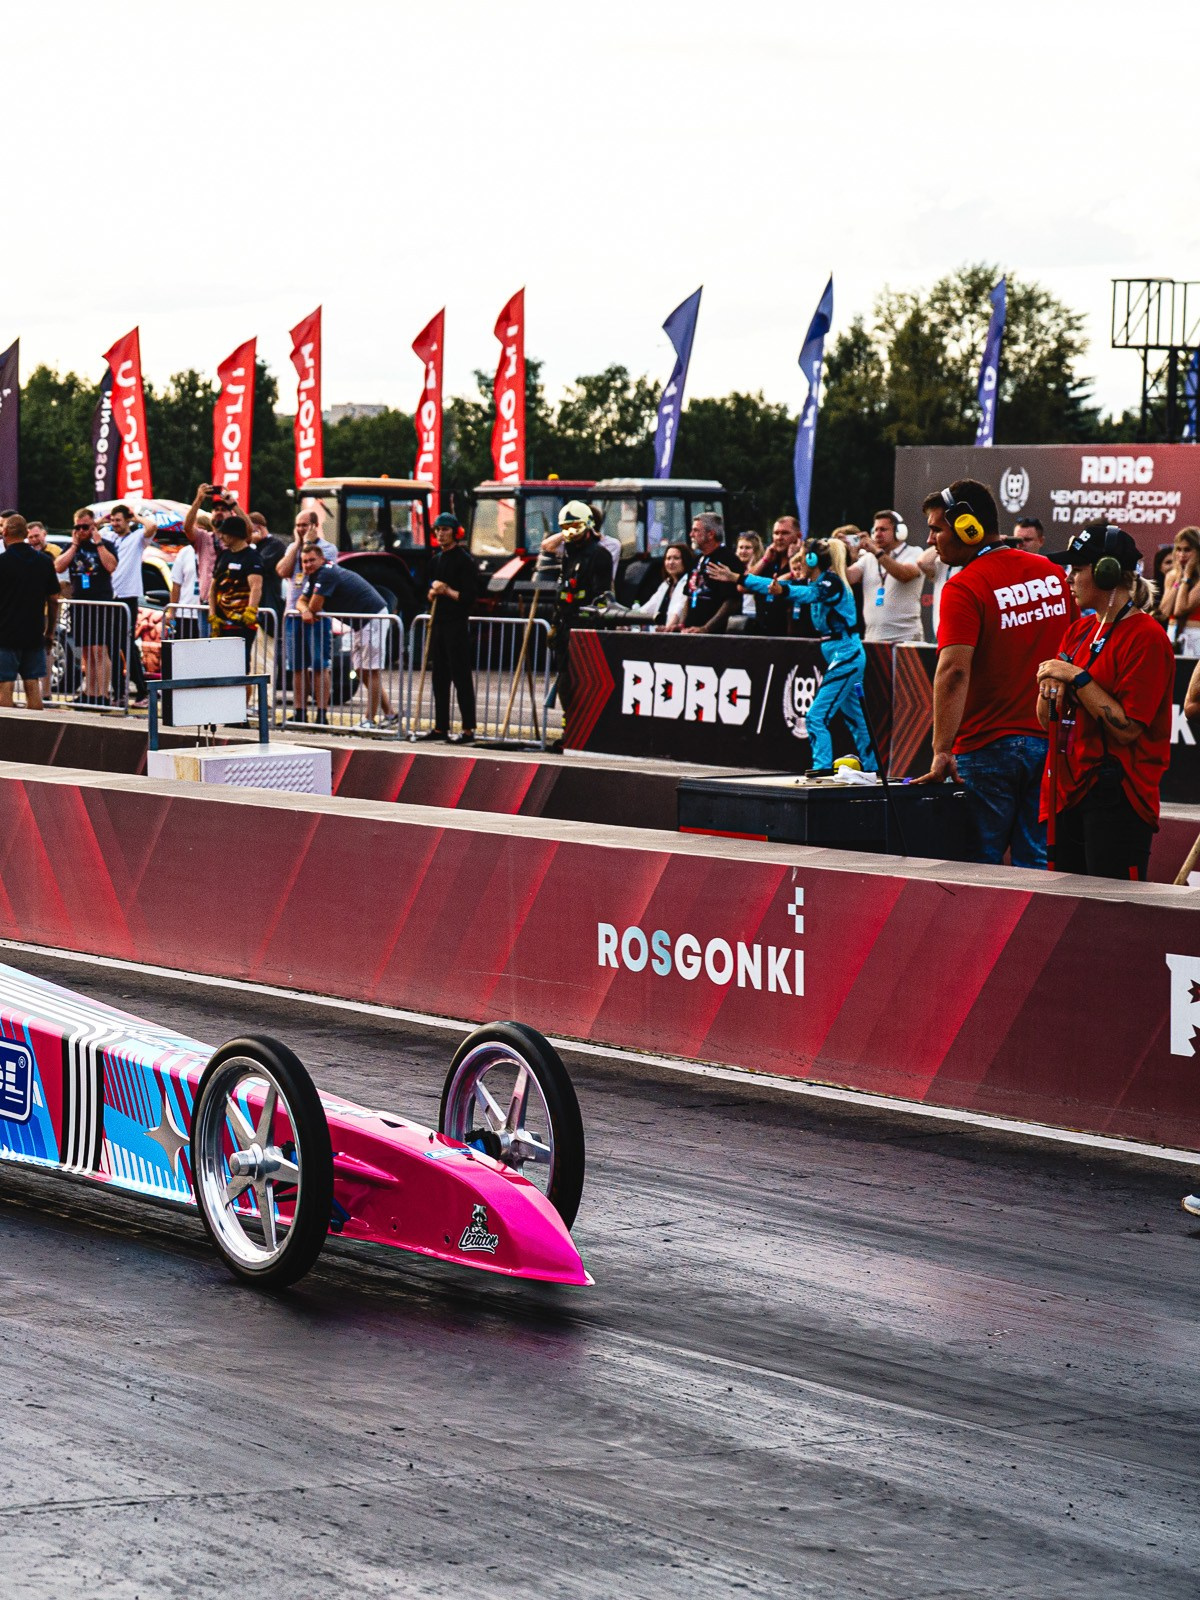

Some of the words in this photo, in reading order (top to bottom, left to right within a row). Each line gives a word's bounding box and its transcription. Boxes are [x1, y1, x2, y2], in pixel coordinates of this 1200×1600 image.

[1081, 456, 1154, 484] RDRC
[1050, 489, 1126, 506] ЧЕМПИОНАТ
[1128, 490, 1181, 507] РОССИИ
[1052, 506, 1071, 522] ПО
[994, 575, 1063, 610] RDRC
[1000, 598, 1067, 630] Marshal
[621, 660, 752, 726] RDRC
[597, 922, 805, 997] ROSGONKI
